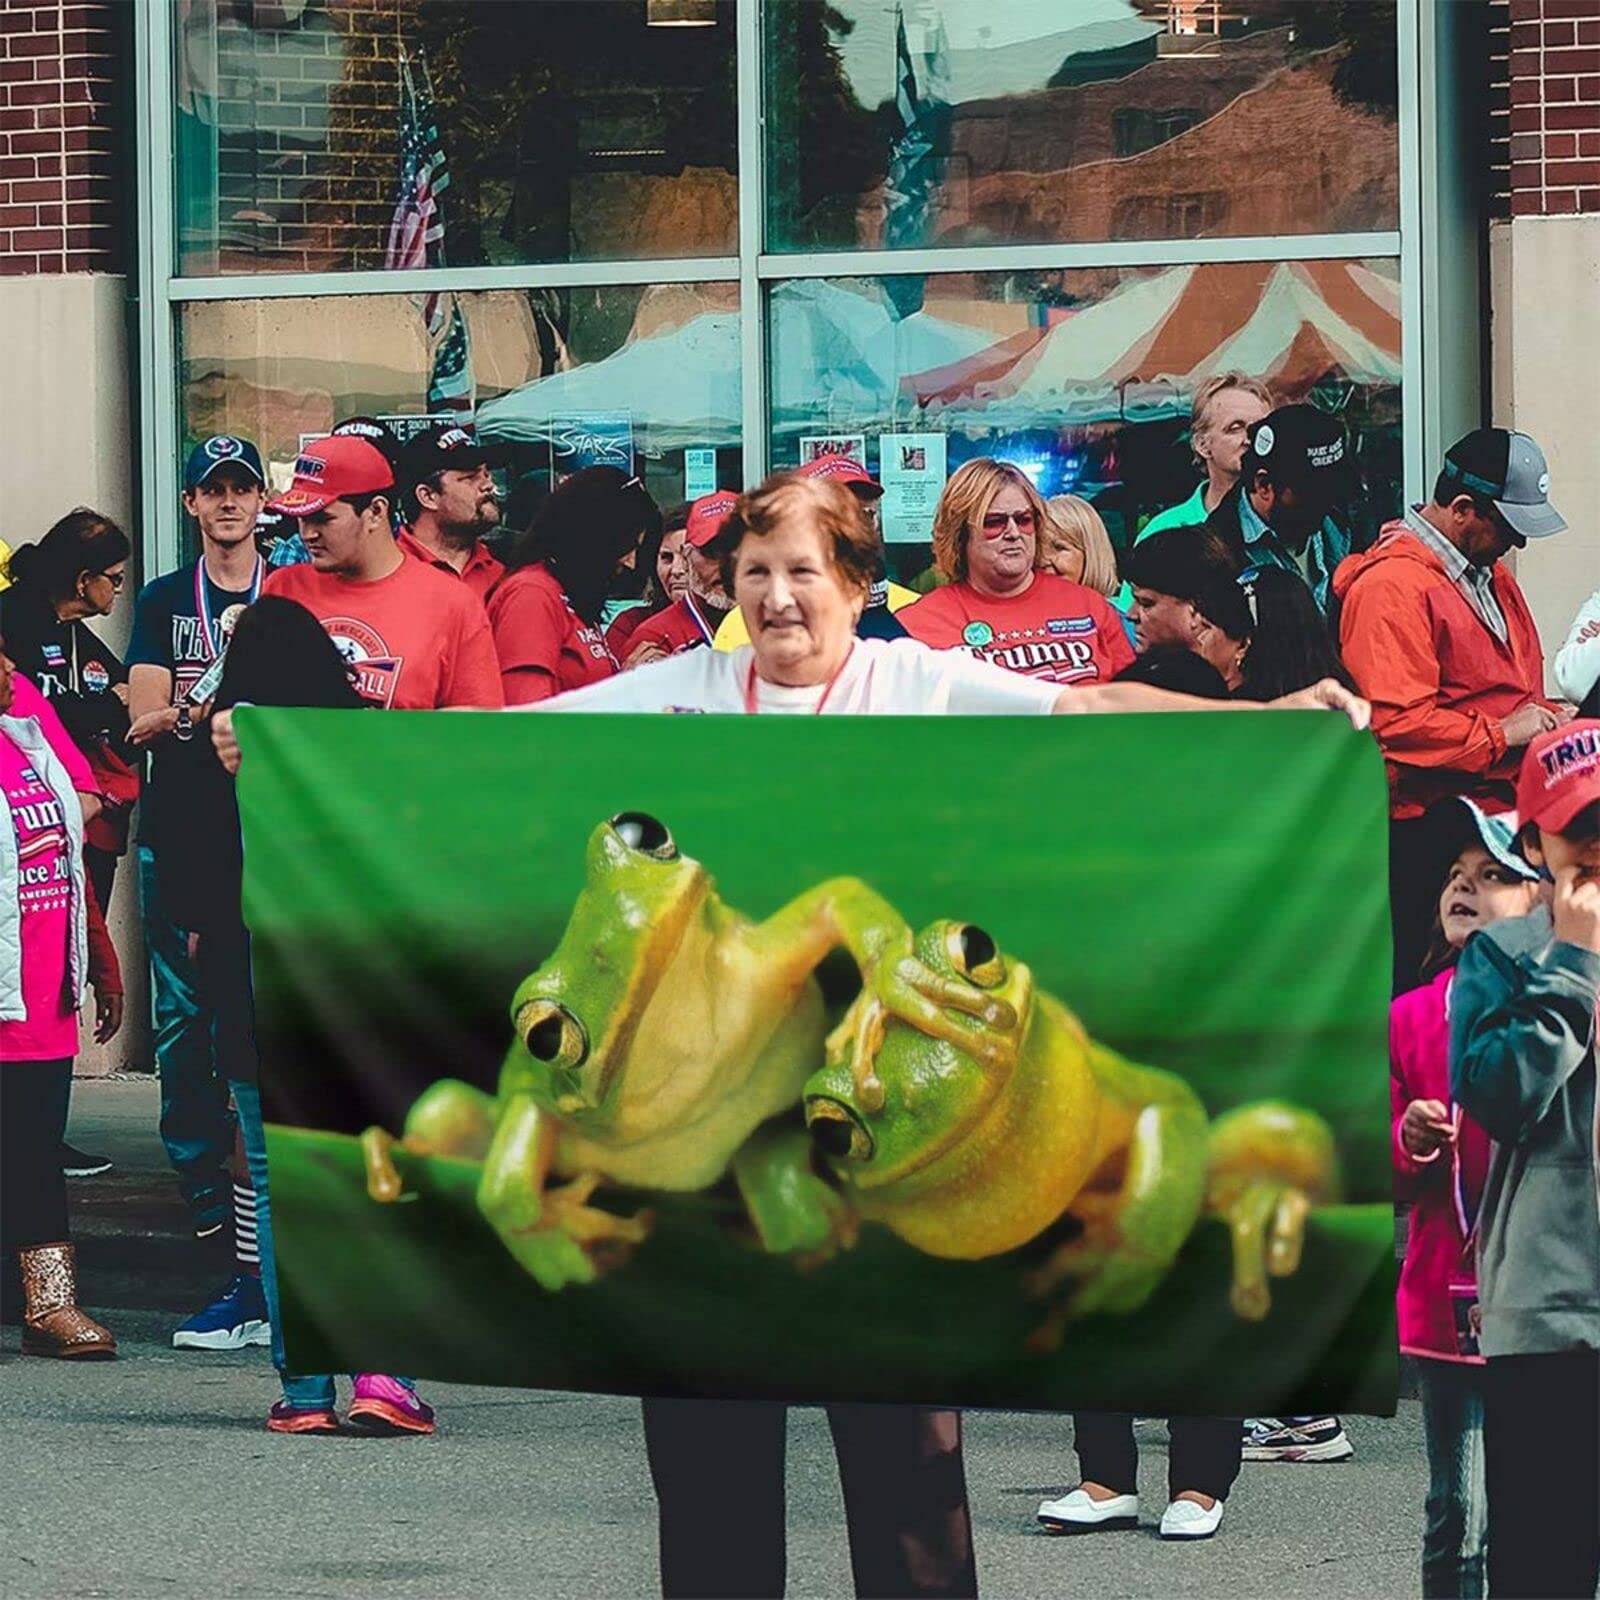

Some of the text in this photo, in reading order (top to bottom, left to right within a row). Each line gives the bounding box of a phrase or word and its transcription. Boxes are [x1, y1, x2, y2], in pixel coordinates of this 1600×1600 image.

[555, 429, 629, 460] STARZ
[354, 671, 387, 696] ALL
[54, 857, 69, 881] 20
